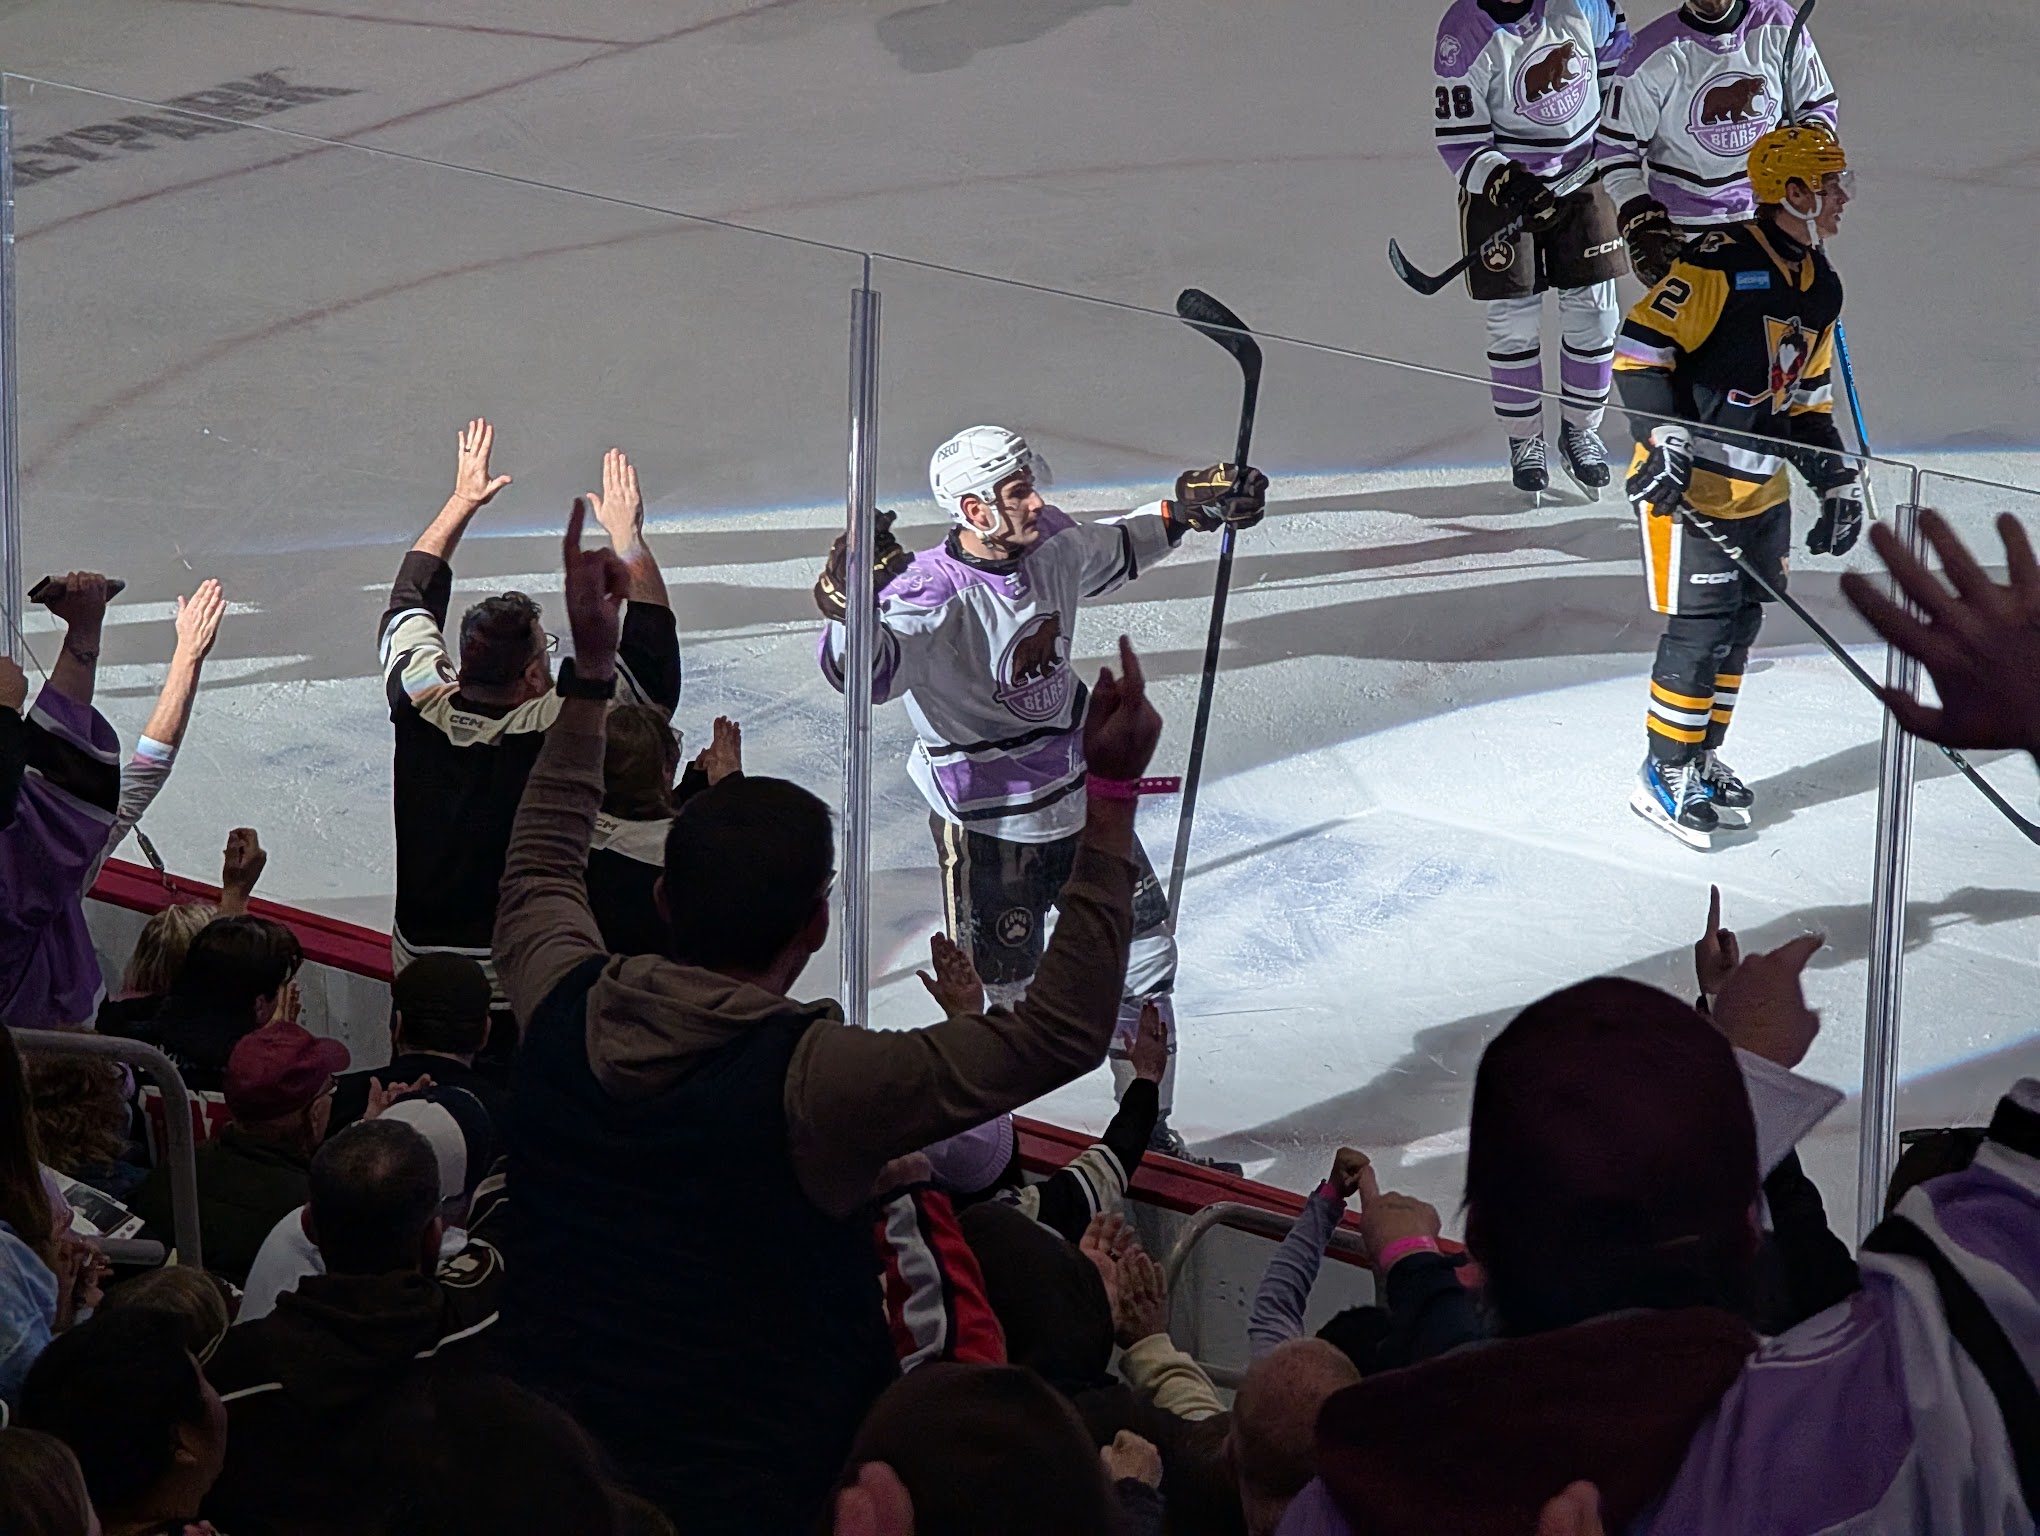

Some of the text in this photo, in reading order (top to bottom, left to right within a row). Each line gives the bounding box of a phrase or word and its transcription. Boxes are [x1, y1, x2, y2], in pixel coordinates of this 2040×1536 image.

[1434, 84, 1475, 120] 38
[1540, 87, 1581, 118] BEARS
[1710, 126, 1757, 149] BEARS
[1583, 236, 1625, 259] CCM
[1649, 276, 1692, 321] 2
[1689, 569, 1740, 585] CCM
[1022, 678, 1064, 712] BEARS
[449, 714, 485, 730] CCM
